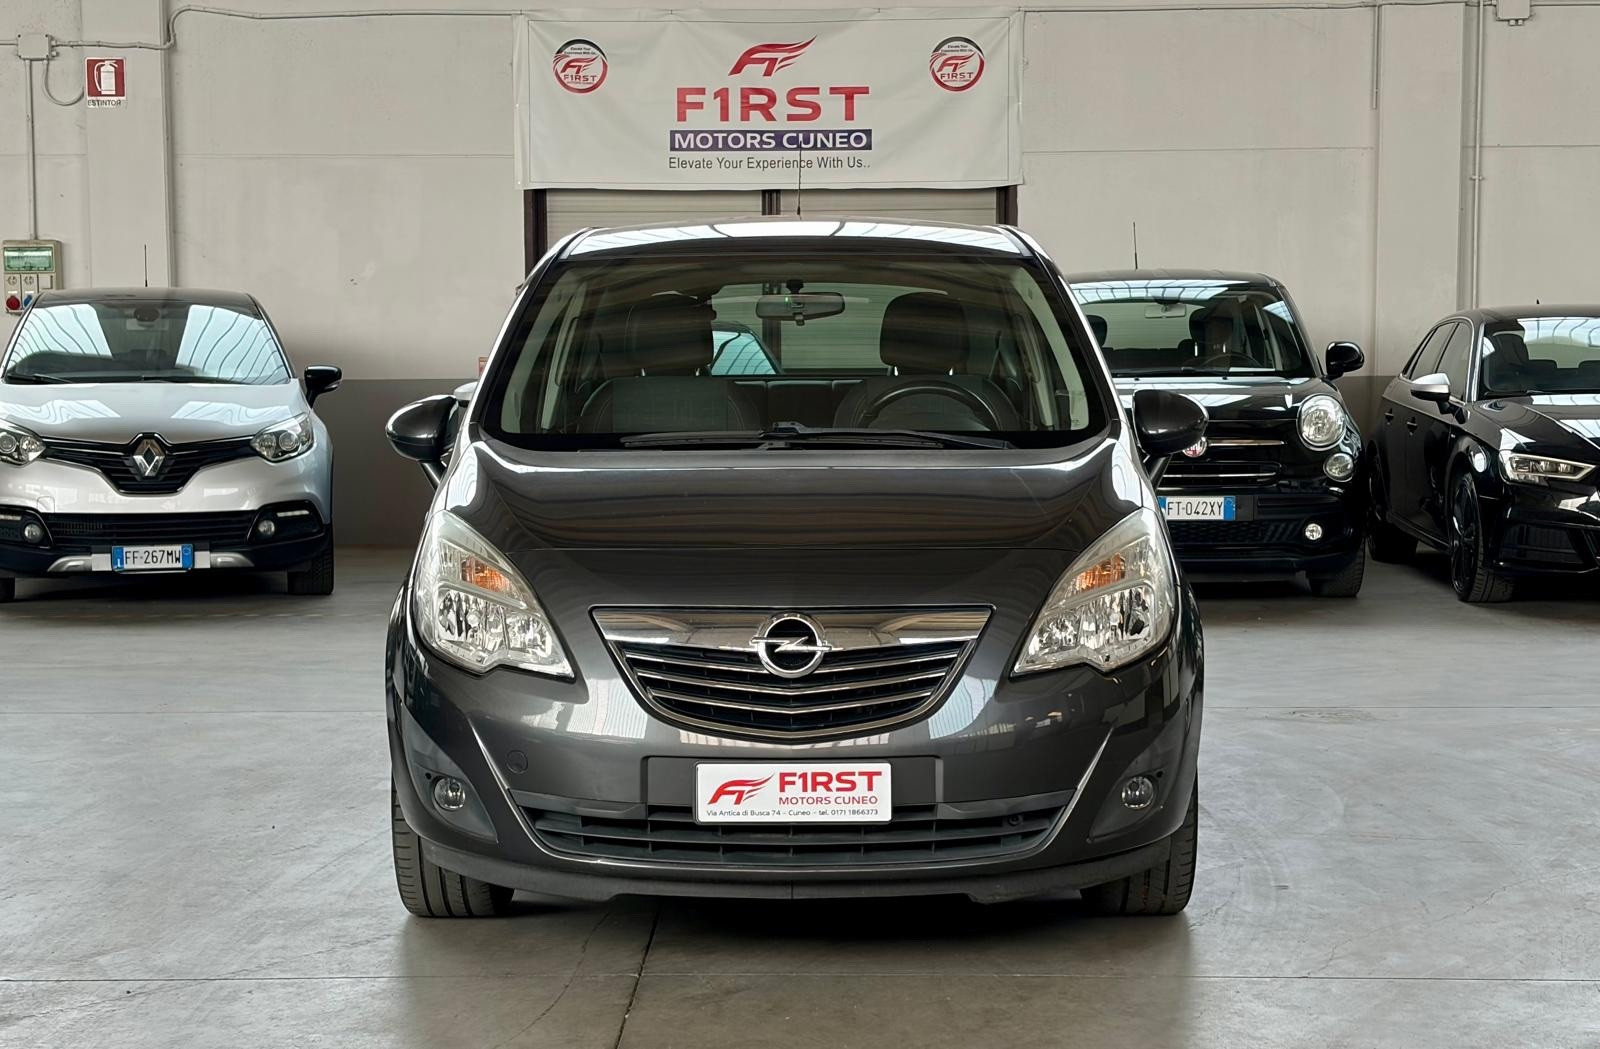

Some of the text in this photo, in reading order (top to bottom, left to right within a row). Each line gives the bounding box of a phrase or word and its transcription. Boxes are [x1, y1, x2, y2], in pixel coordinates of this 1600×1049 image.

[676, 86, 870, 122] F1RST
[674, 132, 867, 149] MOTORS CUNEO
[668, 156, 870, 171] Elevate Your Experience With Us..
[779, 771, 882, 792] F1RST
[779, 796, 878, 805] MOTORS CUNEO
